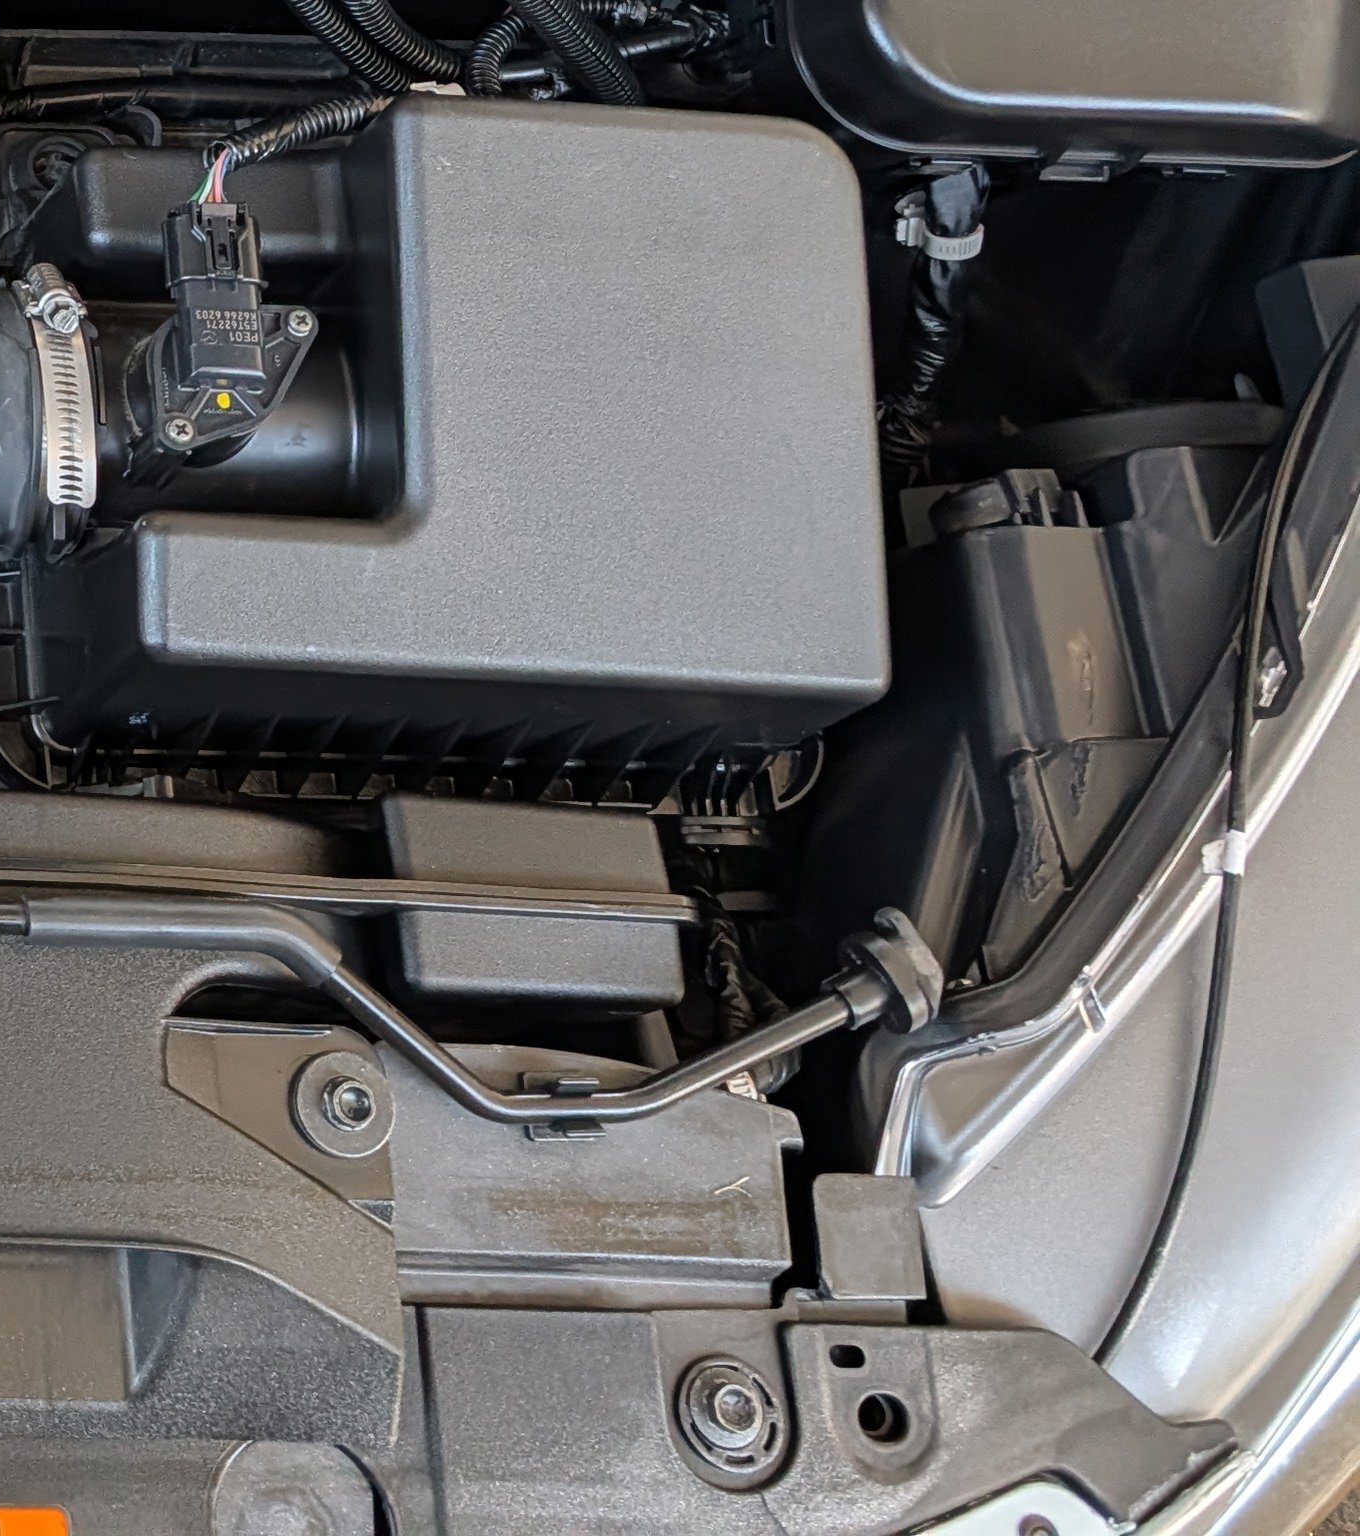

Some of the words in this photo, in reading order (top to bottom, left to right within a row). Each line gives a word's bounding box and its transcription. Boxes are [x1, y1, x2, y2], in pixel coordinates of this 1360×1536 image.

[195, 309, 222, 320] 6203
[206, 320, 258, 331] E5T62271
[229, 331, 259, 343] PE01
